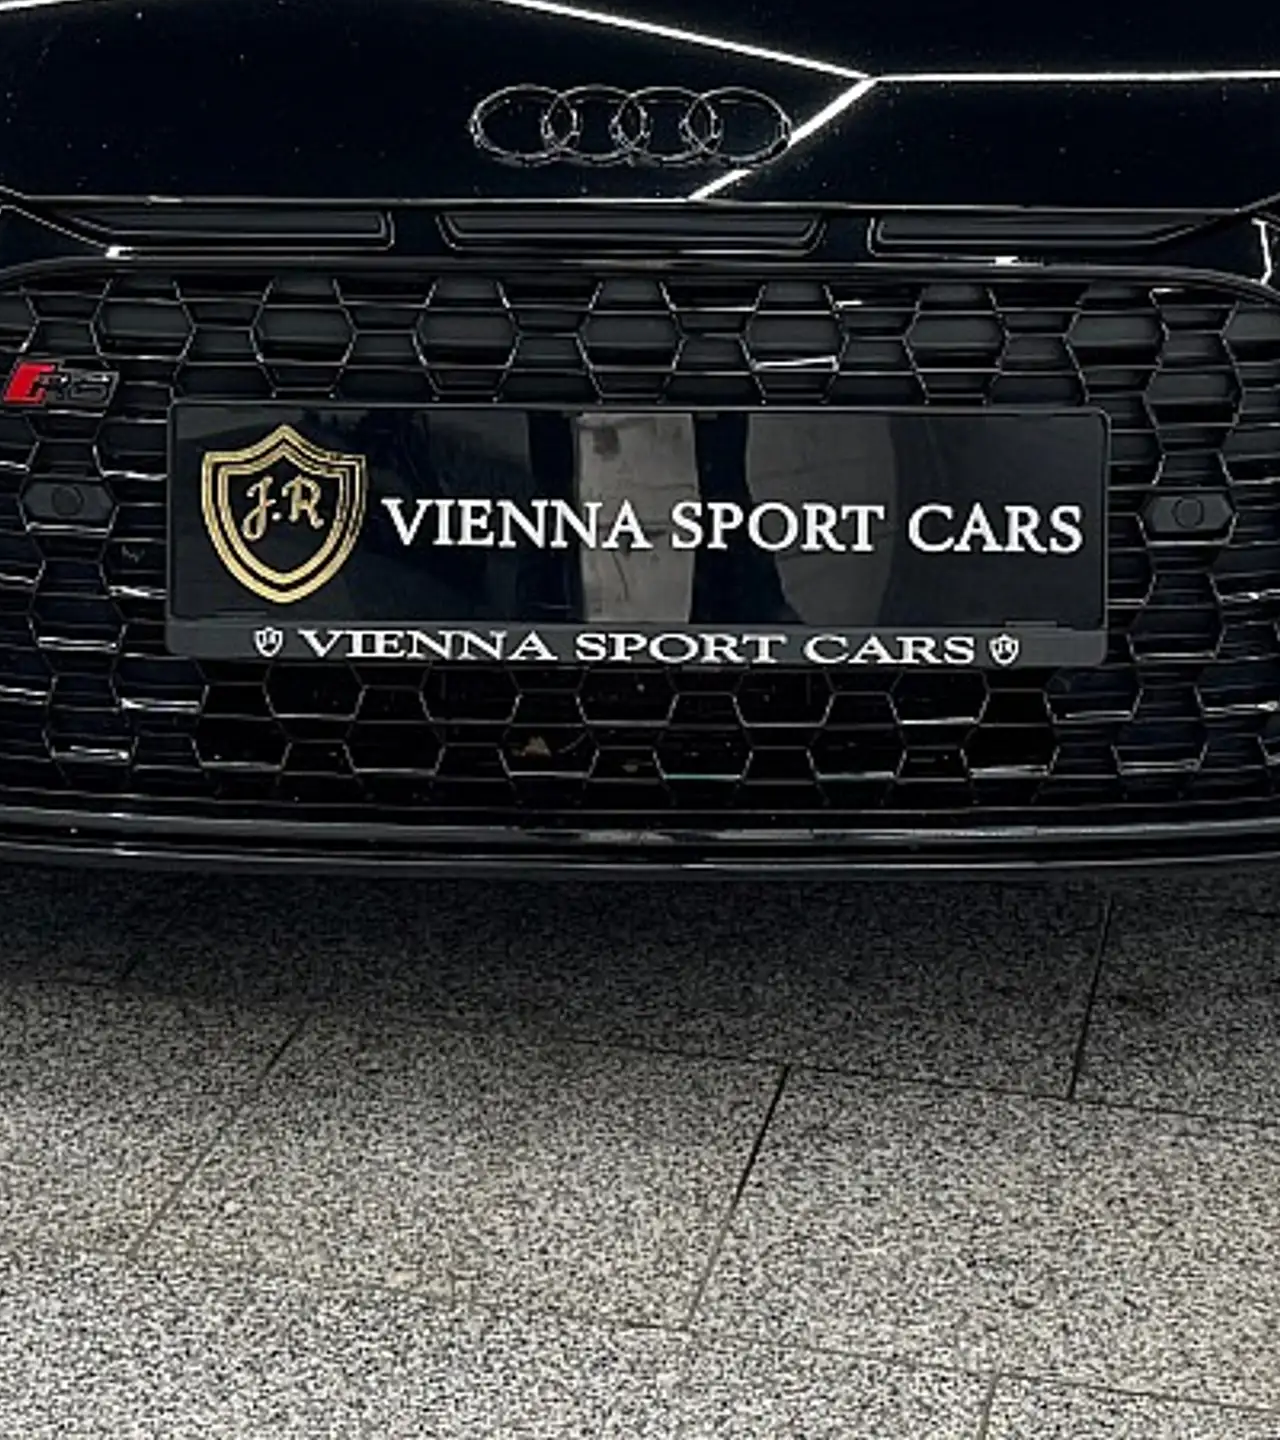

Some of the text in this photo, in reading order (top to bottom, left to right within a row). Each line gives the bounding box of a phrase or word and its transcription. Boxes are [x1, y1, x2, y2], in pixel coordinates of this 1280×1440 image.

[3, 362, 119, 407] R8
[382, 498, 1083, 555] VIENNA SPORT CARS
[298, 629, 558, 661] VIENNA
[575, 632, 787, 663] SPORT
[805, 634, 976, 665] CARS
